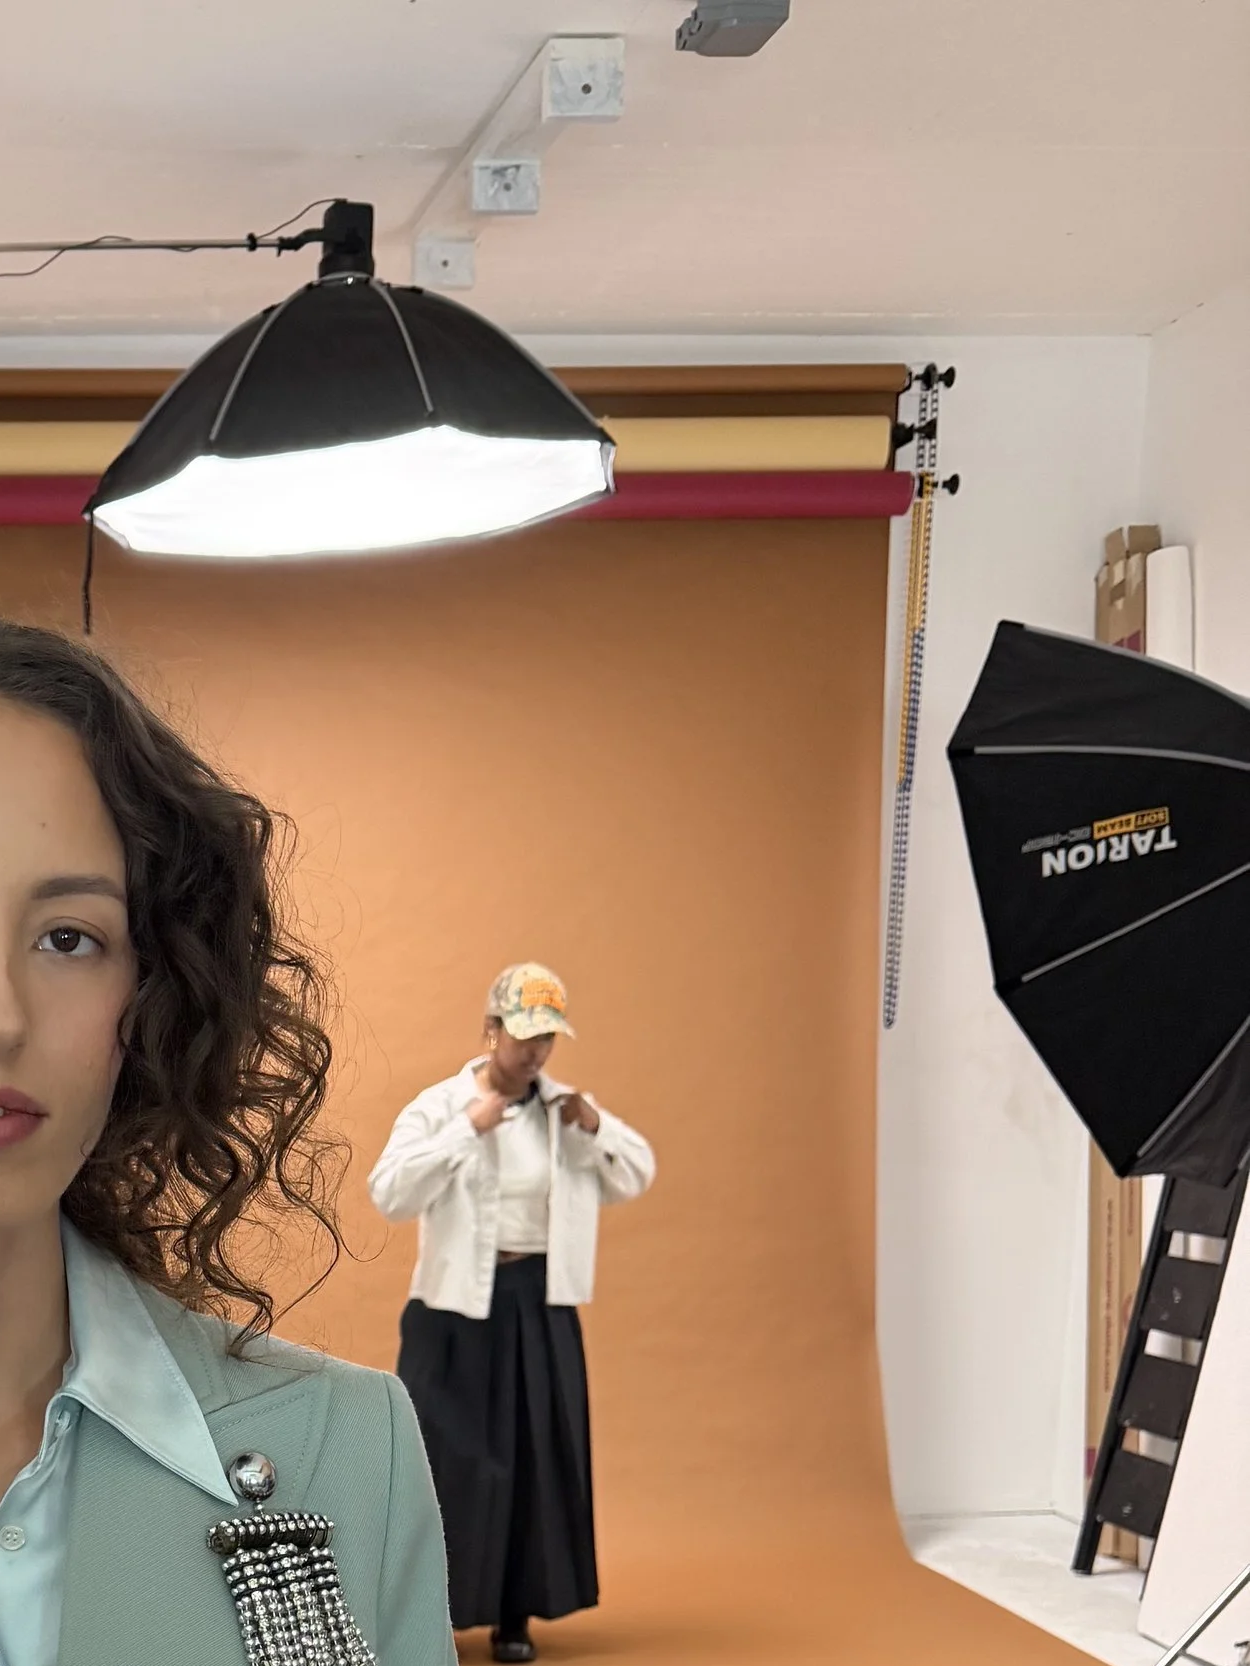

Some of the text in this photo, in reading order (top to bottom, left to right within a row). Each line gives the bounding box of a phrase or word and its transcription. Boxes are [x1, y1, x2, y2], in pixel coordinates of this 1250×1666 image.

[1096, 811, 1166, 834] SOFT BEAM
[1041, 825, 1177, 878] TARION
